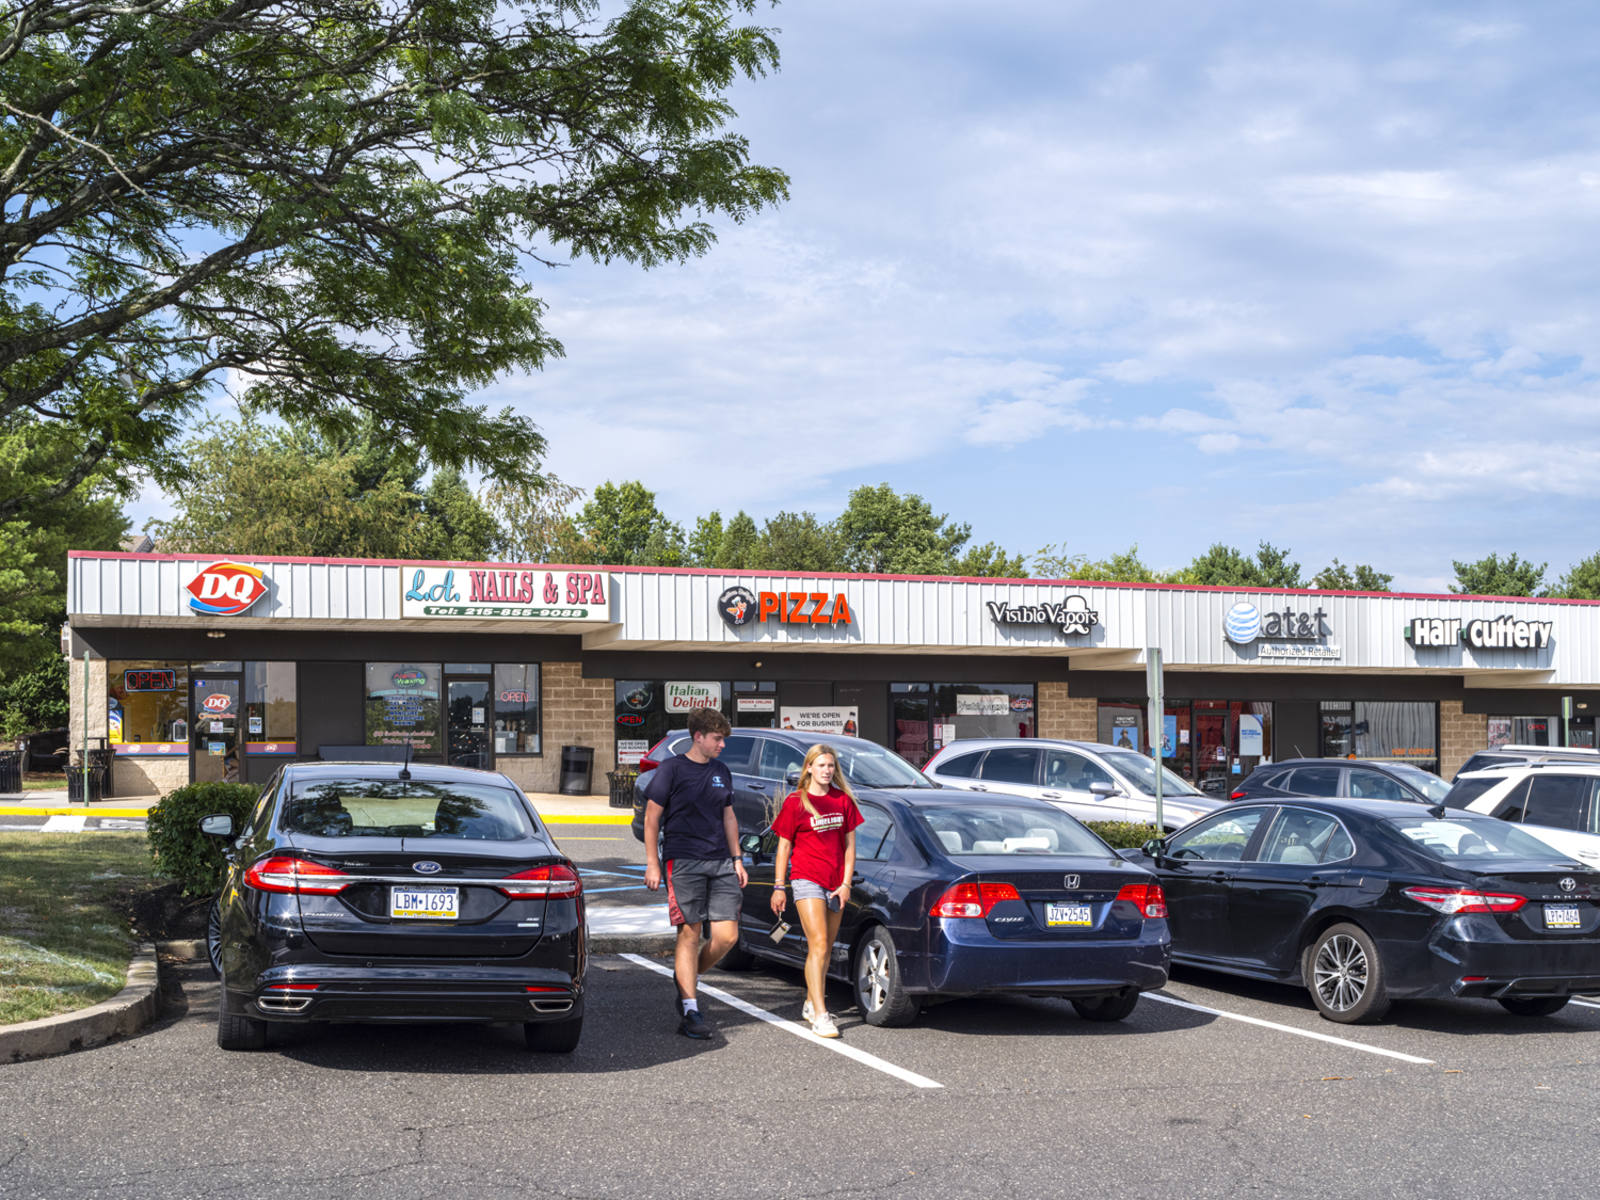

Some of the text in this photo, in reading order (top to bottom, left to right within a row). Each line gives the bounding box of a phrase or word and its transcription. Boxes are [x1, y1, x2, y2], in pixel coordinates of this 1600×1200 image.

[199, 573, 255, 604] DQ
[405, 569, 607, 605] L.A. NAILS & SPA
[429, 606, 583, 618] Tel: 215-855-9088
[759, 591, 852, 624] PIZZA
[987, 601, 1098, 626] Visible Vapors
[1263, 606, 1328, 638] at&t
[1411, 618, 1462, 647] Hair
[1260, 645, 1339, 657] Authorized Retailer
[127, 671, 174, 689] OPEN
[500, 691, 529, 703] OPEN
[670, 684, 710, 696] Italian
[208, 698, 227, 708] DQ
[672, 696, 718, 709] Delight
[617, 716, 643, 724] OPEN
